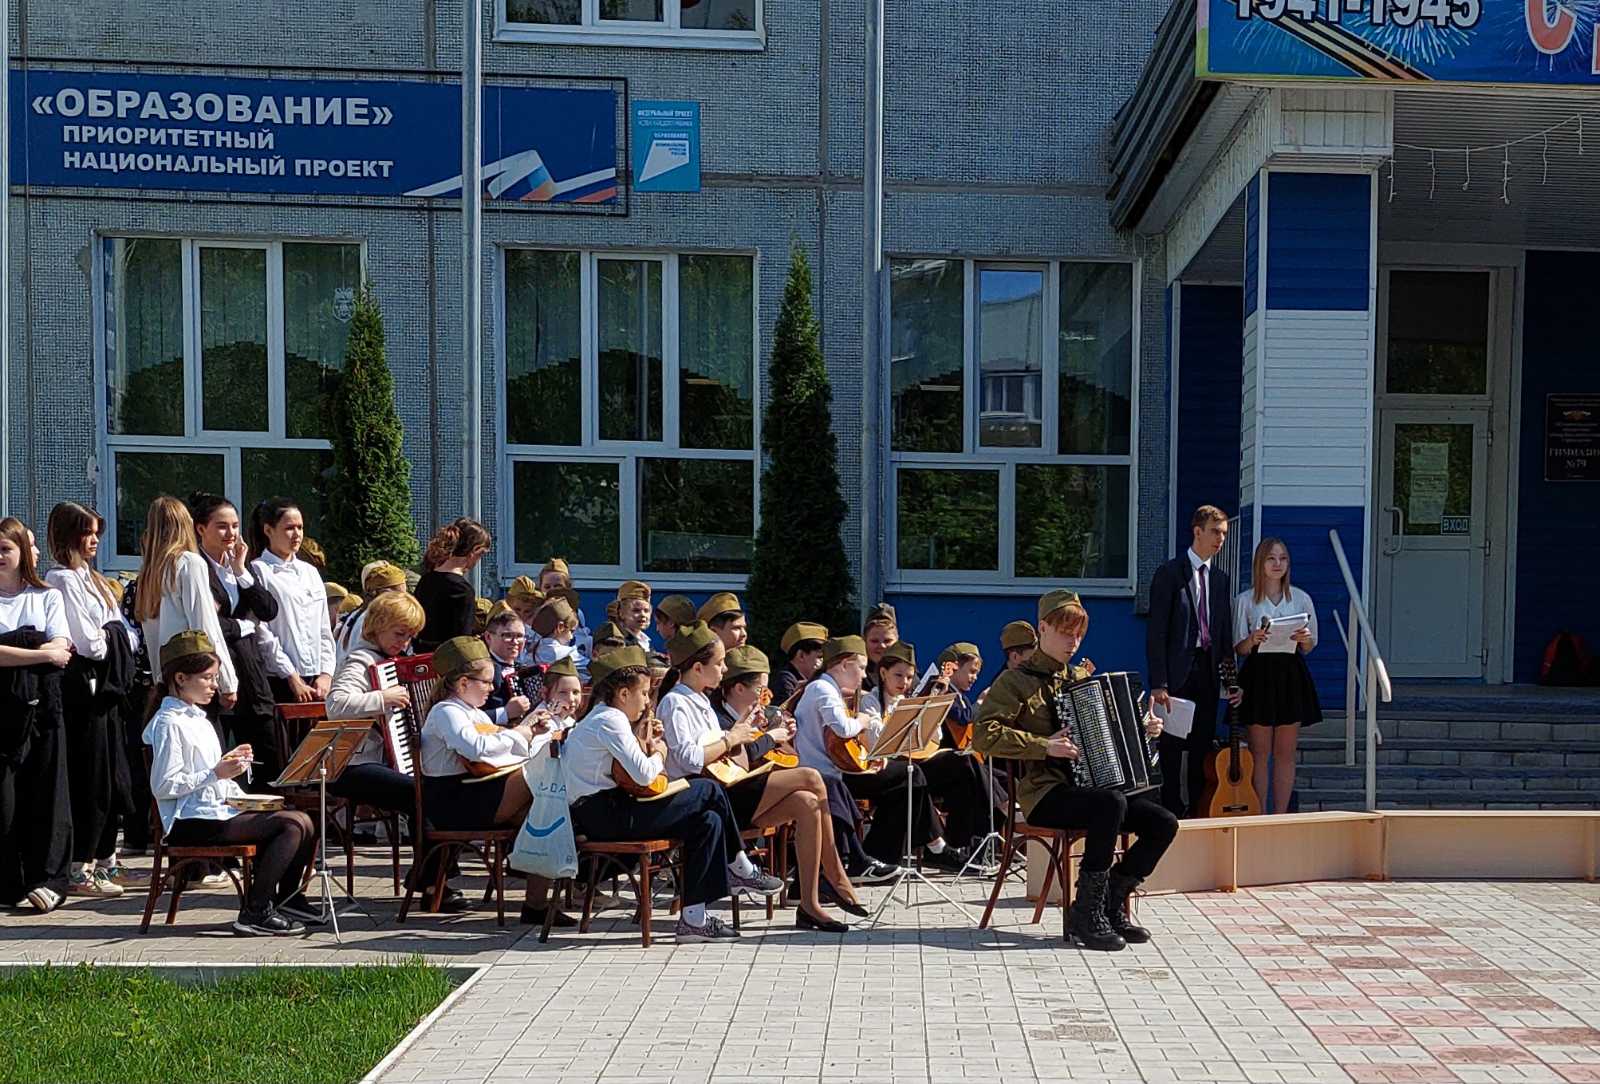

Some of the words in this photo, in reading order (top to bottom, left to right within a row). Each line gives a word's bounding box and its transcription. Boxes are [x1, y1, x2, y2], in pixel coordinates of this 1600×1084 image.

[32, 88, 393, 126] «ОБРАЗОВАНИЕ»
[63, 126, 275, 150] ПРИОРИТЕТНЫЙ
[63, 151, 285, 176] НАЦИОНАЛЬНЫЙ
[294, 159, 394, 178] ПРОЕКТ
[1443, 518, 1469, 532] ВХОД
